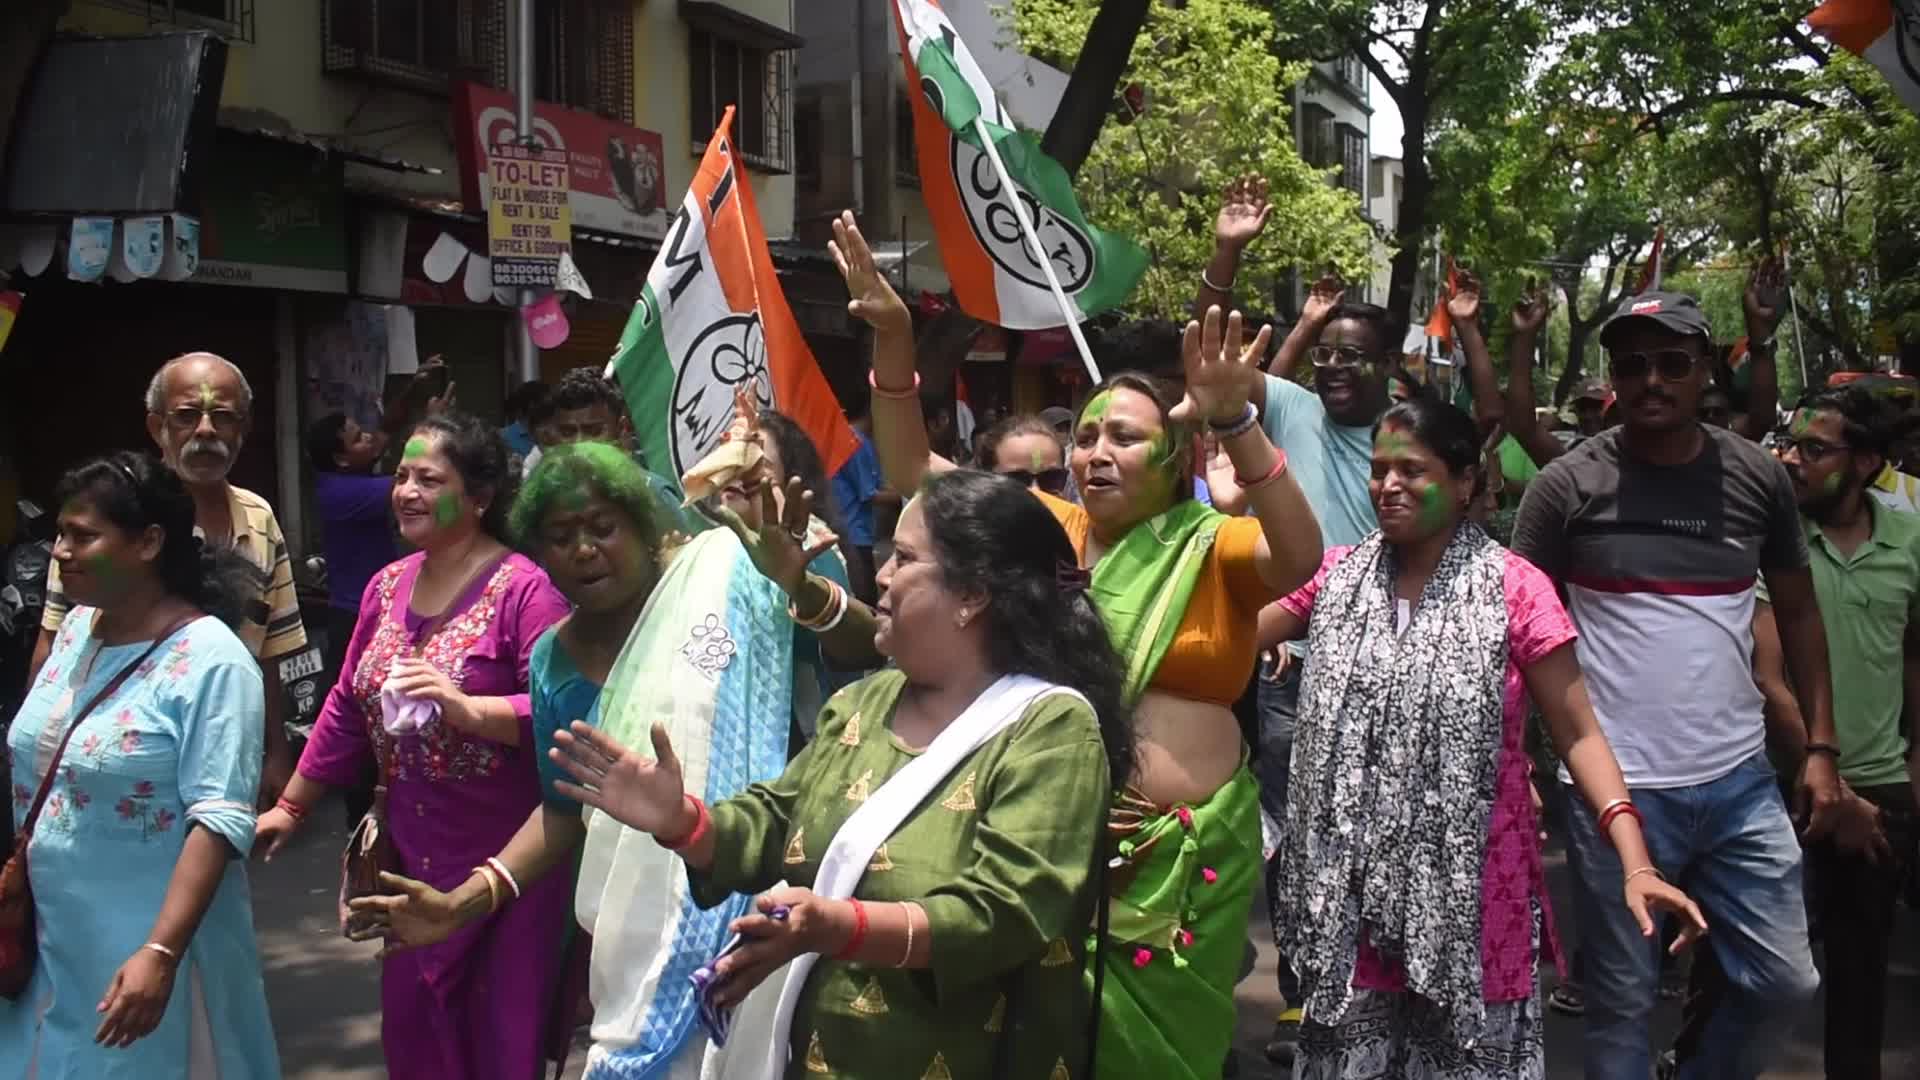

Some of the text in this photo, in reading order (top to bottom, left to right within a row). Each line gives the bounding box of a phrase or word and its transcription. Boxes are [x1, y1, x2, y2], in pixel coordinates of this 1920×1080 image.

[492, 160, 566, 187] TO-LET
[491, 188, 512, 202] FLAT
[552, 191, 568, 205] FOR
[502, 204, 523, 217] RENT
[539, 207, 560, 220] SALE
[512, 224, 552, 239] RENT FOR
[492, 240, 524, 253] OFFICE
